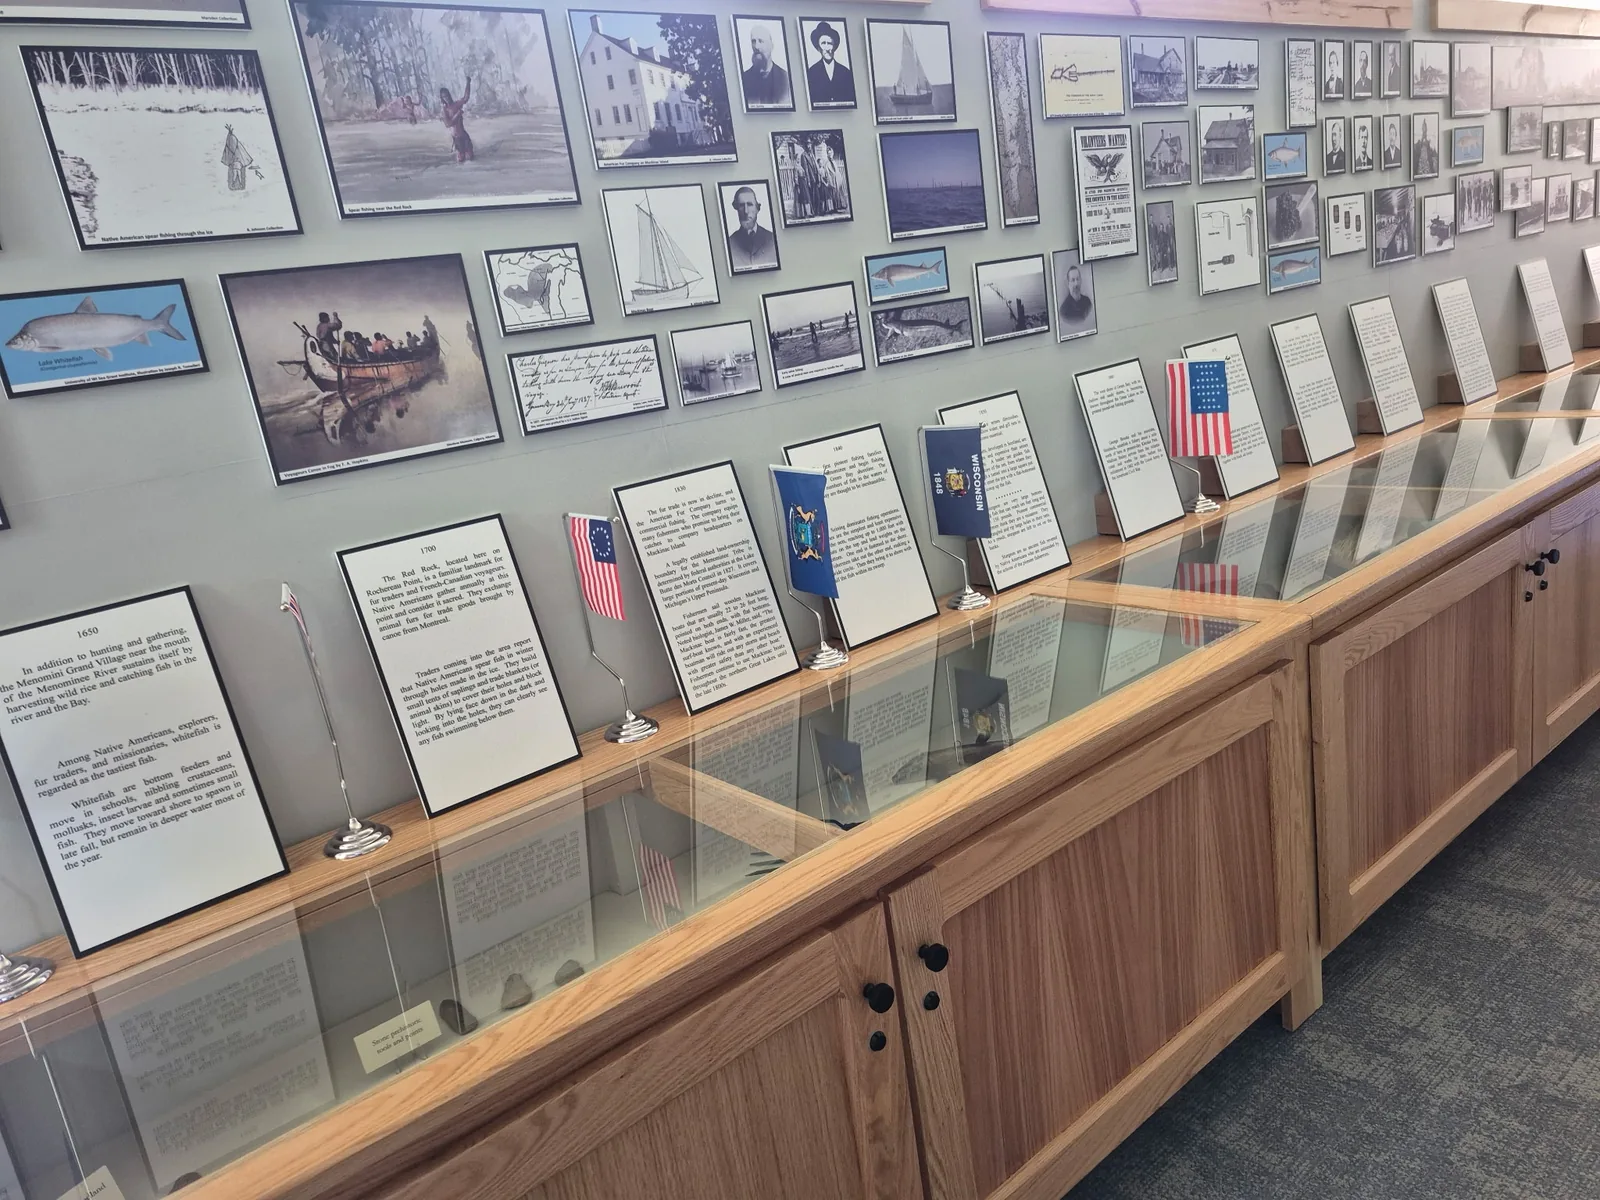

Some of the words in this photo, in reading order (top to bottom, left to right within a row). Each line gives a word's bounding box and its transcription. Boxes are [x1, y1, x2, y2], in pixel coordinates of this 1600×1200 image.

[54, 356, 83, 364] Whitefish
[933, 472, 943, 495] 1848
[971, 454, 984, 511] WISCONSIN
[649, 513, 672, 524] American
[688, 503, 711, 513] Company
[420, 544, 437, 554] 1700
[365, 583, 402, 597] Rochereau
[402, 577, 423, 587] Point,
[437, 567, 462, 578] familiar
[463, 558, 493, 571] landmark
[400, 568, 416, 578] Red
[420, 563, 440, 573] Rock,
[445, 555, 468, 566] located
[371, 604, 395, 614] Native
[399, 593, 433, 607] Americans
[436, 587, 456, 598] gather
[459, 578, 485, 590] annually
[497, 572, 509, 580] this
[381, 592, 404, 602] traders
[405, 586, 419, 596] and
[419, 573, 473, 592] French-Canadian
[76, 626, 99, 638] 1650
[0, 684, 14, 693] the
[15, 668, 64, 688] Menomini
[65, 660, 94, 675] Grand
[94, 654, 127, 666] Village
[128, 648, 147, 658] near
[148, 644, 162, 652] the
[163, 635, 190, 648] mouth
[21, 667, 33, 675] In
[36, 657, 74, 672] addition
[89, 643, 124, 657] hunting
[126, 636, 143, 647] and
[145, 627, 187, 644] gathering,
[3, 693, 14, 704] of
[17, 690, 33, 699] the
[36, 675, 90, 694] Menominee
[92, 667, 118, 679] River
[121, 657, 155, 671] sustains
[158, 648, 180, 660] itself
[181, 646, 192, 654] by
[5, 696, 56, 714] harvesting
[56, 687, 78, 699] wild
[79, 684, 97, 694] rice
[99, 676, 116, 688] and
[117, 668, 154, 683] catching
[155, 662, 172, 672] fish
[172, 659, 183, 667] in
[183, 656, 197, 664] the
[10, 713, 33, 724] river
[34, 706, 53, 718] and
[53, 703, 68, 712] the
[68, 697, 90, 708] Bay.
[34, 778, 48, 788] fur
[52, 767, 87, 781] traders,
[91, 757, 109, 769] and
[112, 741, 168, 763] missionaries,
[171, 726, 210, 743] whitefish
[57, 754, 91, 769] Among
[92, 743, 123, 757] Native
[128, 728, 175, 747] Americans,
[178, 714, 218, 730] explorers,
[37, 778, 78, 798] regarded
[78, 776, 90, 784] as
[90, 771, 105, 781] the
[106, 760, 137, 776] tastiest
[137, 754, 157, 766] fish.
[371, 1035, 390, 1047] Stone
[376, 1044, 392, 1054] tools
[393, 1037, 405, 1046] and
[405, 1026, 424, 1042] points
